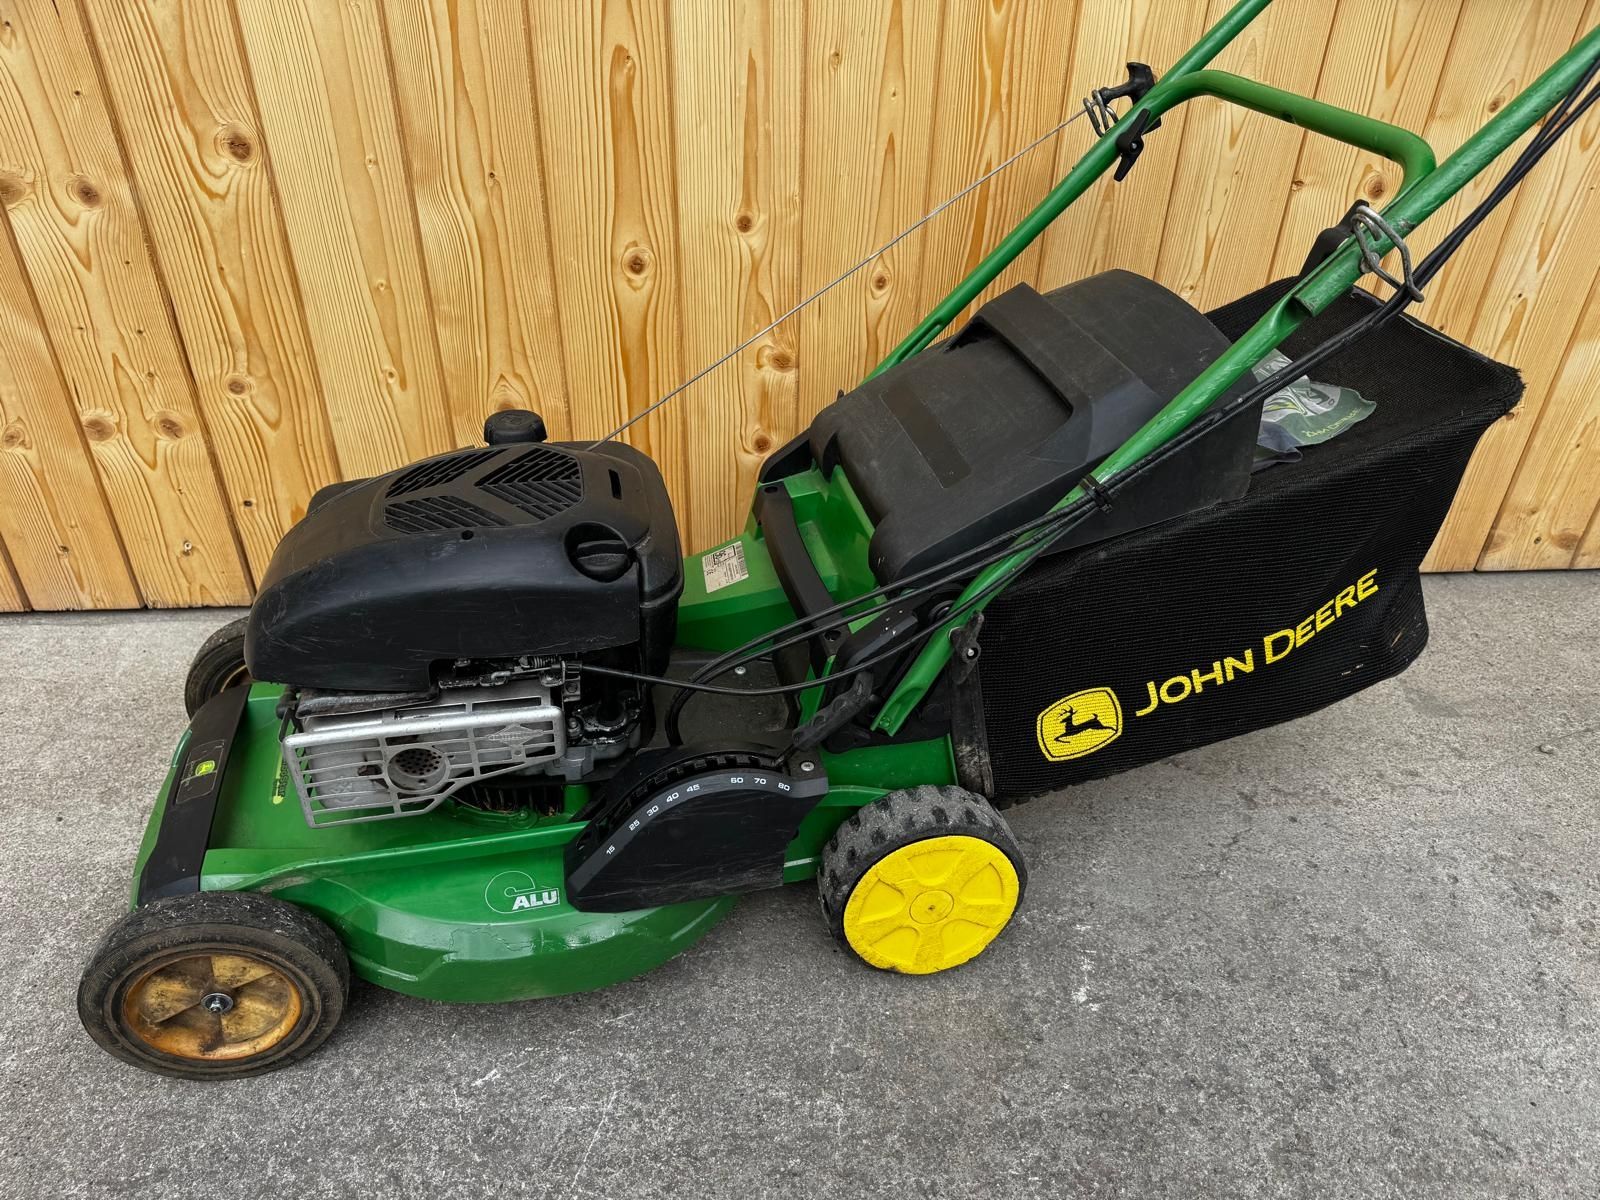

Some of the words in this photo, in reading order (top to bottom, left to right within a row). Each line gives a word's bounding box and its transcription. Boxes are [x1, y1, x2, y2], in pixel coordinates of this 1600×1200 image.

[1135, 647, 1255, 717] JOHN
[1263, 568, 1379, 665] DEERE
[606, 845, 616, 855] 15
[629, 820, 640, 831] 25
[646, 805, 659, 816] 30
[666, 792, 679, 802] 40
[754, 777, 767, 785] 70
[778, 782, 791, 792] 80
[512, 890, 558, 910] ALU
